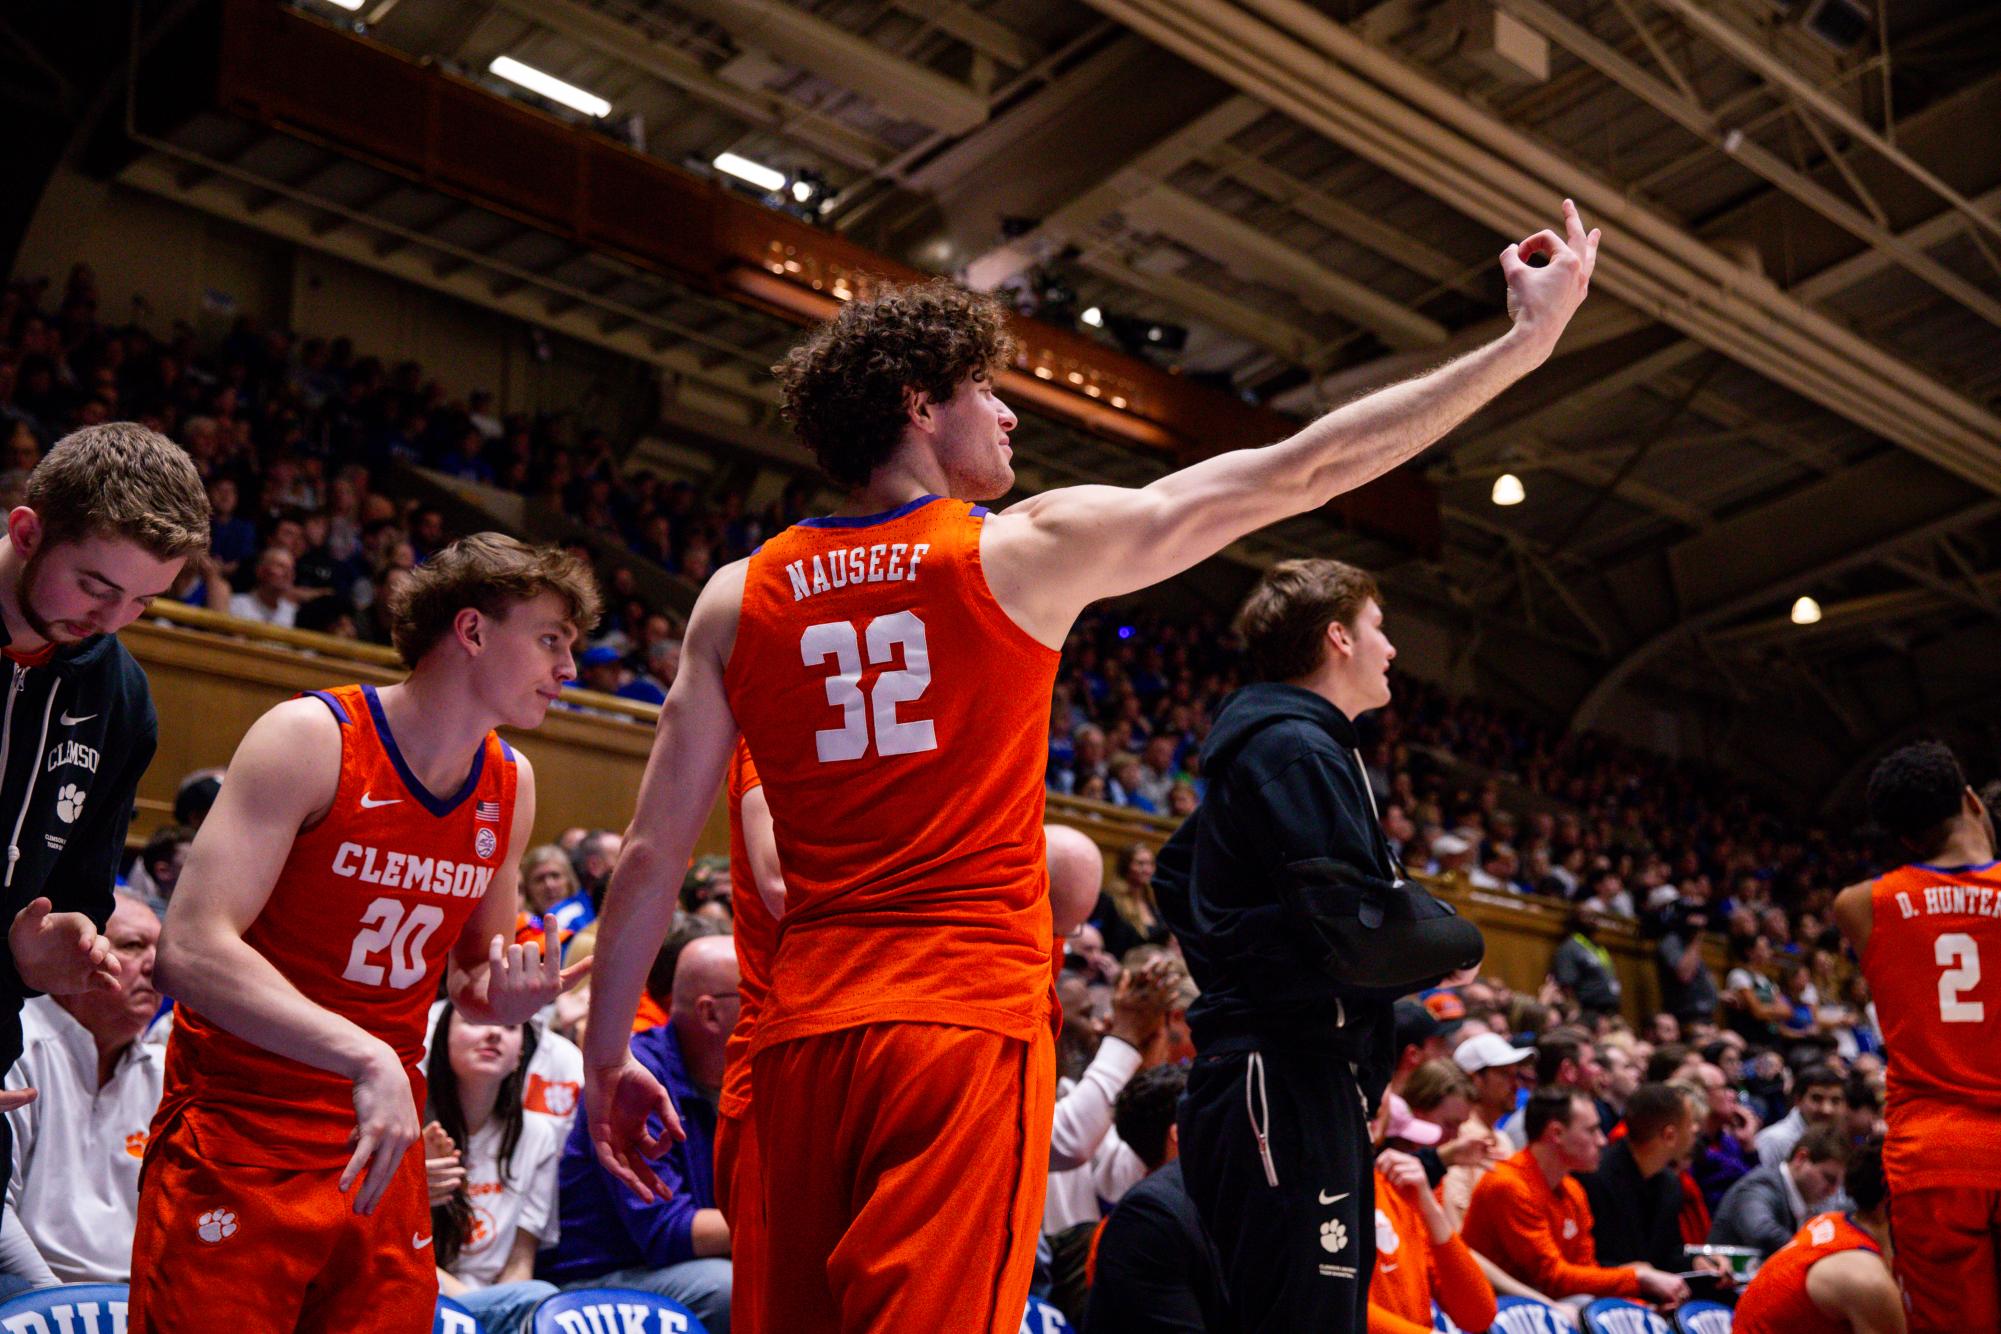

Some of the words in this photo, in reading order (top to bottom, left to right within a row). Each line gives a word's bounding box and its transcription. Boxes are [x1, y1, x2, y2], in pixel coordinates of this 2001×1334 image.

[785, 543, 931, 602] NAUSEEF
[800, 609, 938, 763] 32
[332, 841, 495, 899] CLEMSON
[1895, 891, 1920, 920] D.
[341, 896, 445, 990] 20
[1933, 932, 1985, 1023] 2
